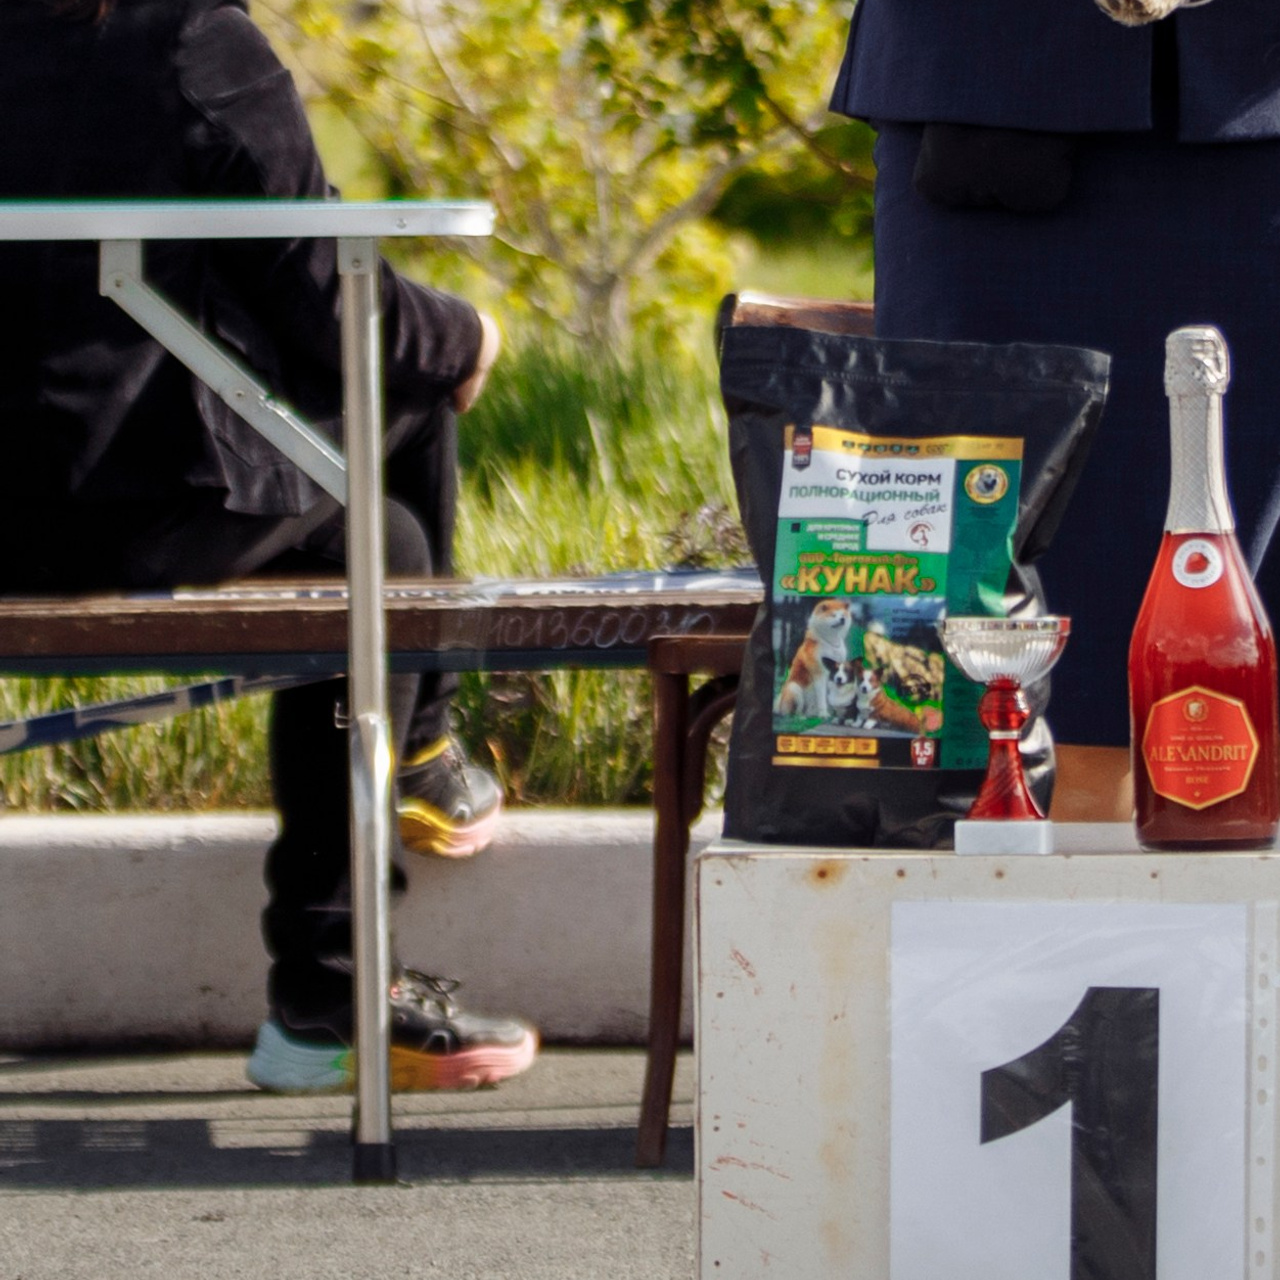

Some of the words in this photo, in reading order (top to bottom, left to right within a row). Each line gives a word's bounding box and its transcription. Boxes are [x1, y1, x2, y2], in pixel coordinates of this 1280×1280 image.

[836, 469, 891, 485] СУХОЙ
[895, 473, 942, 485] КОРМ
[789, 485, 941, 503] ПОЛНОРАЦИОННЫЙ
[862, 510, 896, 527] Для
[904, 503, 948, 519] собак
[781, 565, 936, 595] «КУНАК»
[913, 741, 933, 757] 1,5
[980, 986, 1160, 1280] 1
